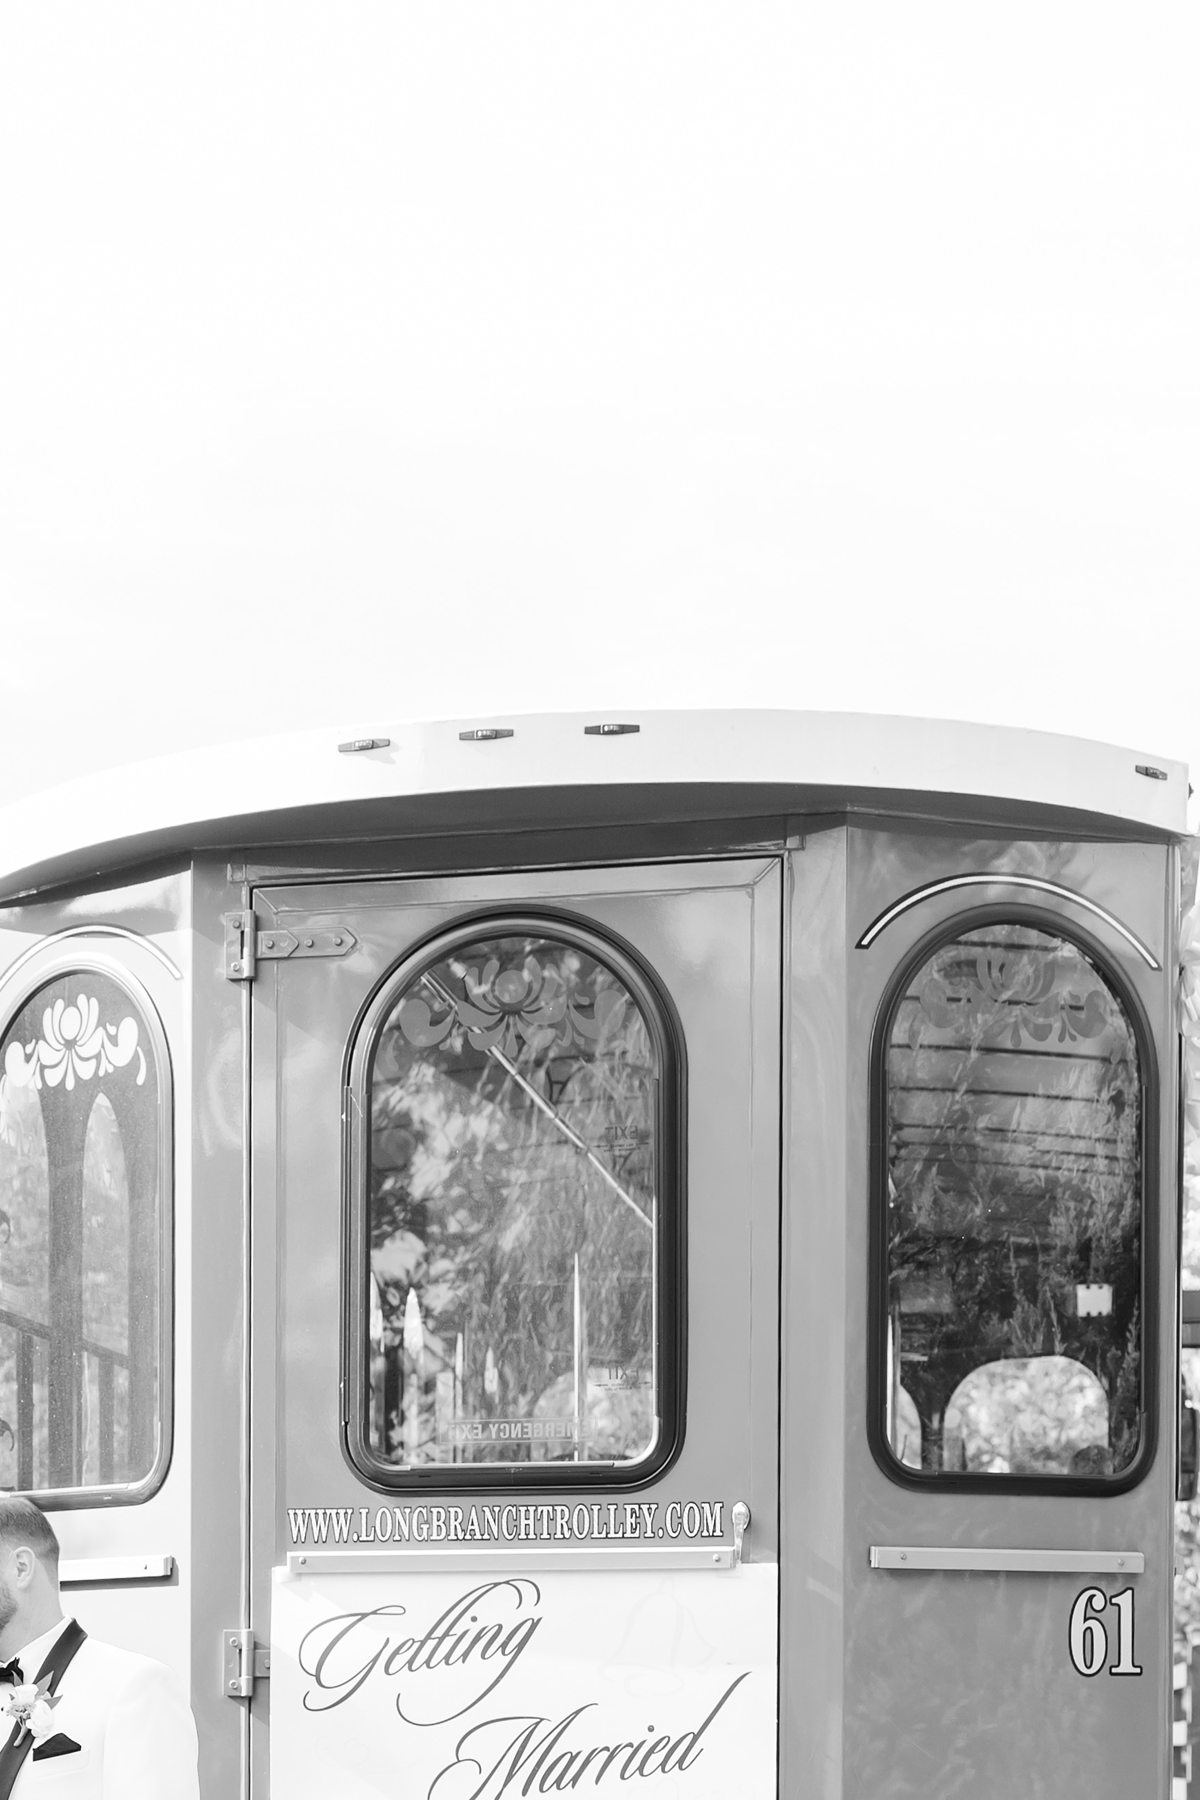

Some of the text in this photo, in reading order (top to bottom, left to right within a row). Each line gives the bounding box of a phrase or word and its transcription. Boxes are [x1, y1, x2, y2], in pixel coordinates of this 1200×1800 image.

[287, 1501, 724, 1544] WWW.LONGBRANCHTROLLEY.COM
[298, 1578, 542, 1726] Getting
[1068, 1586, 1143, 1677] 61
